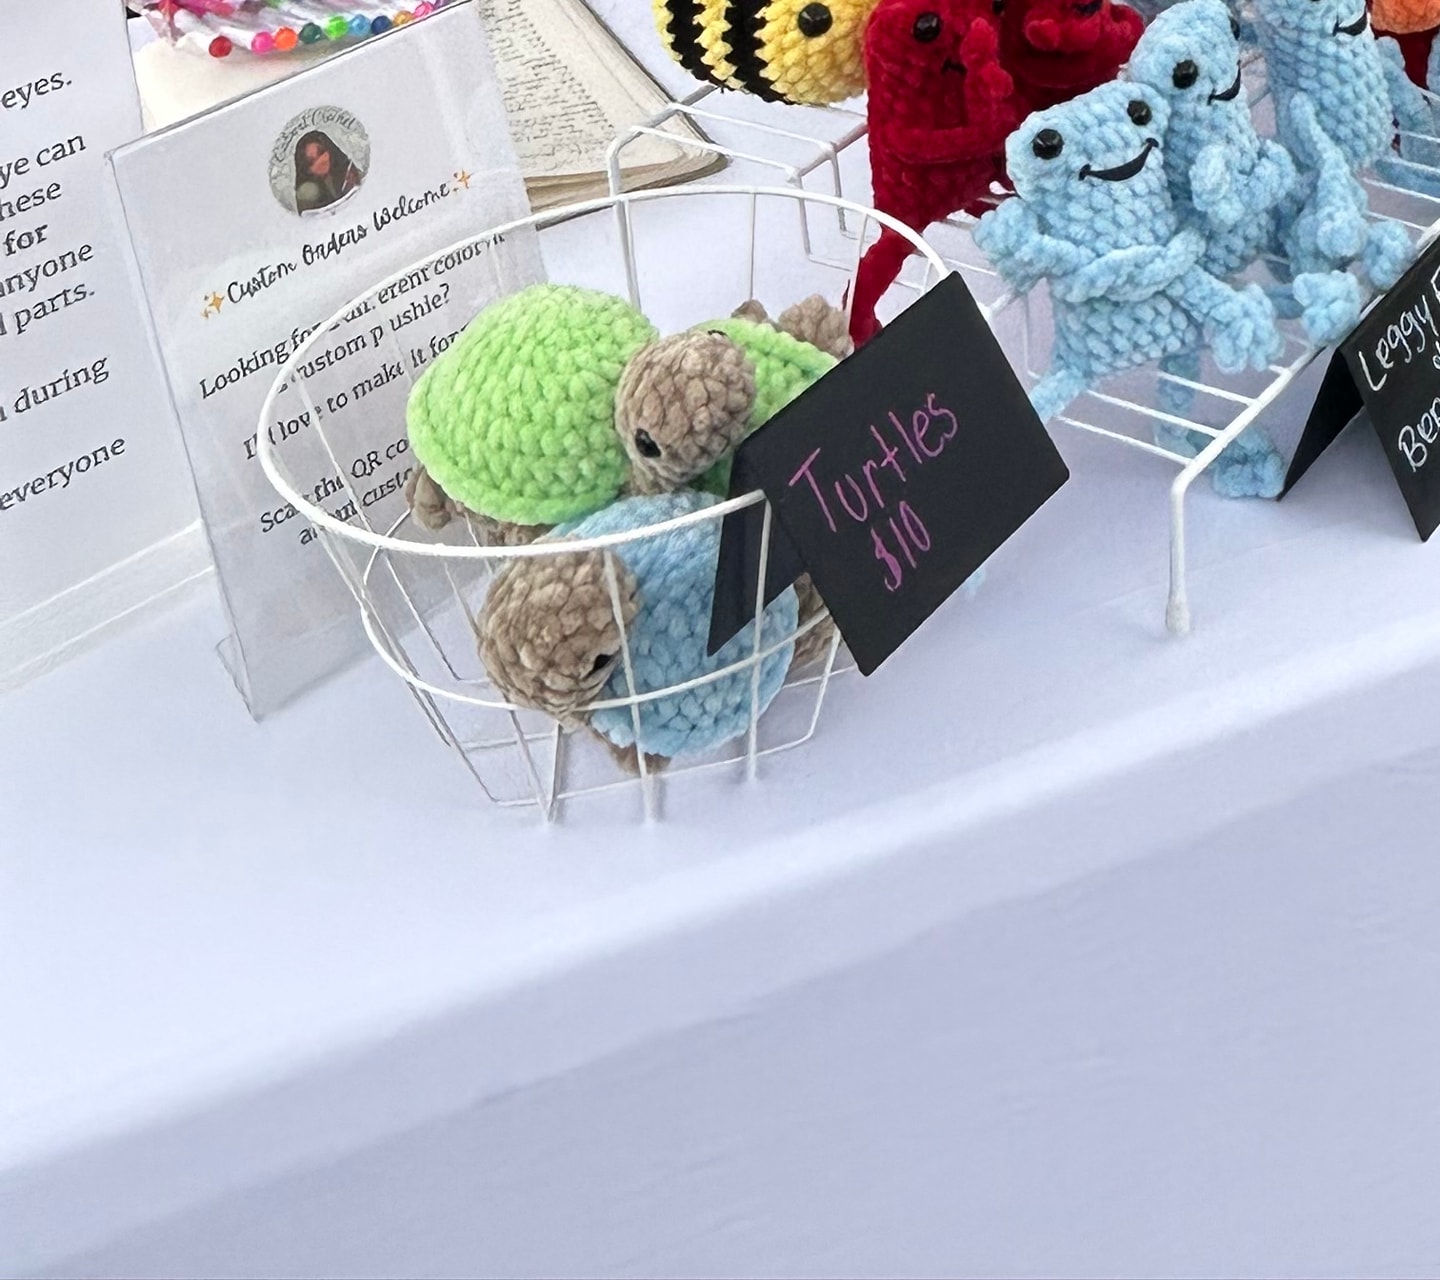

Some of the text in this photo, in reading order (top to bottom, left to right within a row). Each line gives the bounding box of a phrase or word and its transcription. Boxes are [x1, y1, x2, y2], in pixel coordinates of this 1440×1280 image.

[1, 71, 72, 110] eyes.
[36, 135, 87, 168] can
[372, 181, 450, 232] Welcome
[4, 223, 49, 257] for
[14, 283, 95, 335] parts.
[1358, 295, 1440, 391] Leggy
[13, 356, 110, 414] during
[199, 338, 293, 400] Looking
[327, 392, 348, 413] to
[351, 450, 382, 479] QR
[788, 393, 958, 533] Turtles
[870, 500, 931, 592] $10
